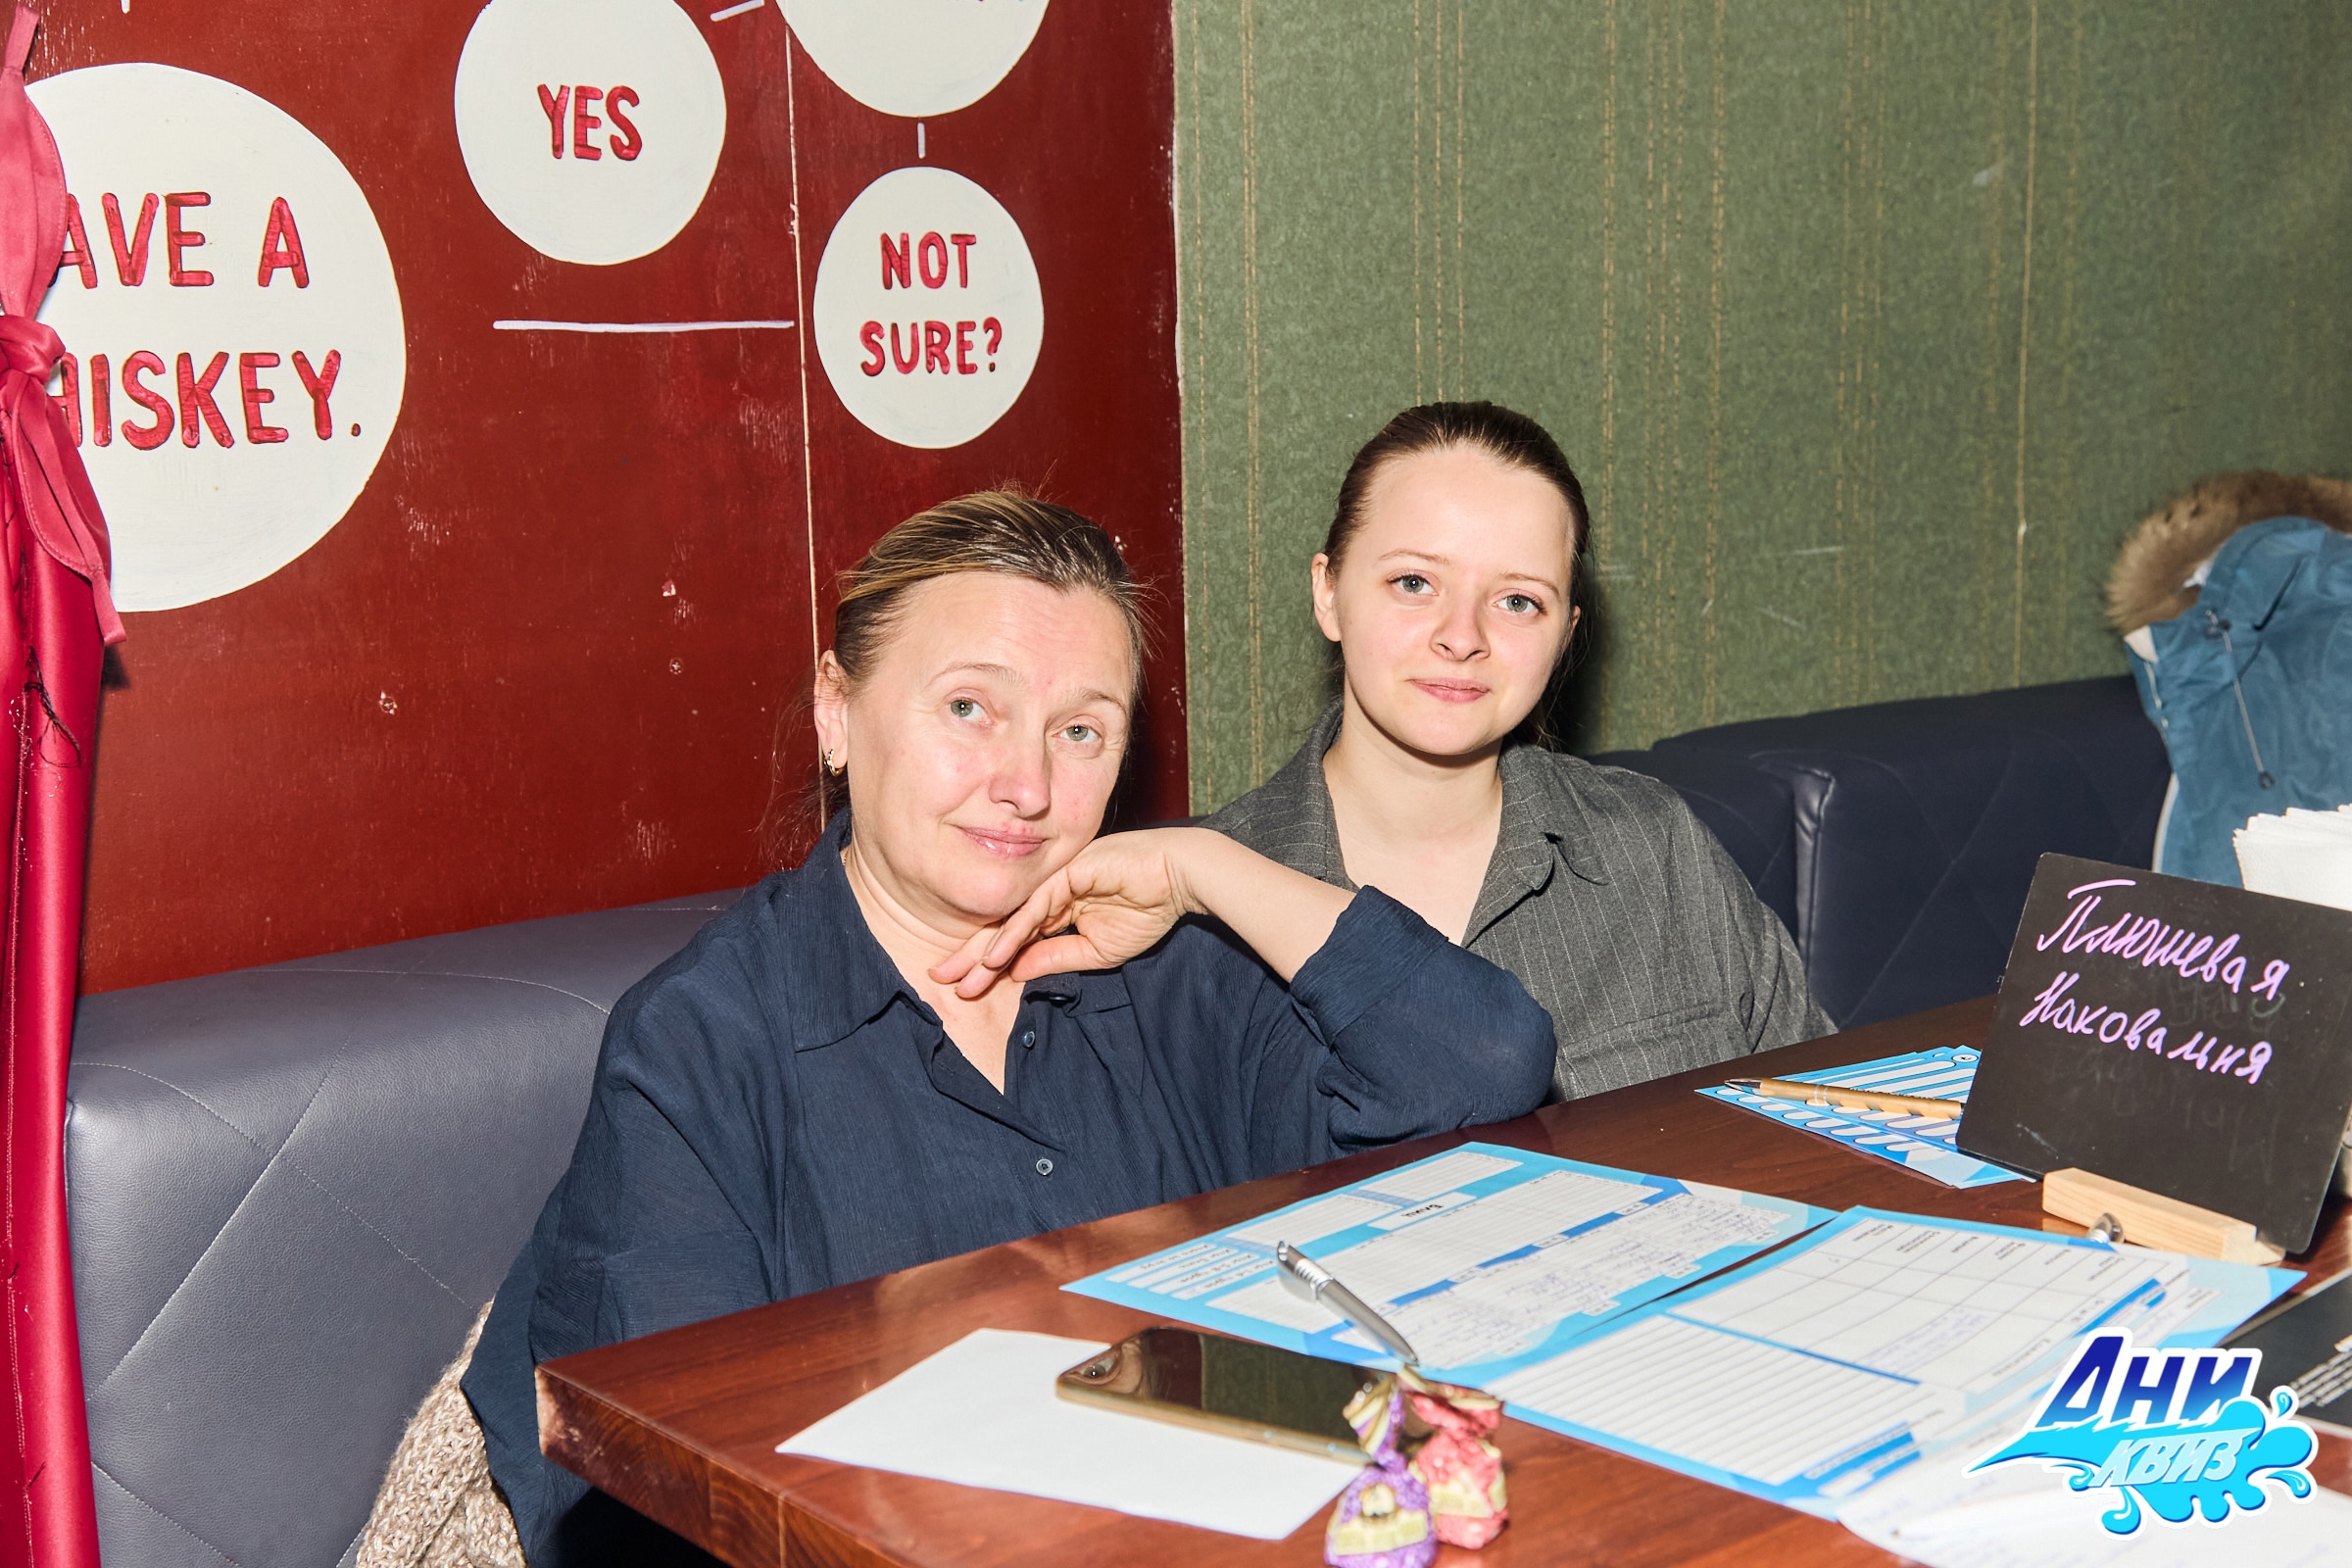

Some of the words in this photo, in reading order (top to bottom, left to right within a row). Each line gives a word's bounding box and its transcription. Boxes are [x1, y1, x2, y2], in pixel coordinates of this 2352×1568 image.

[536, 82, 643, 162] YES
[47, 191, 215, 289] AVE
[257, 195, 311, 288] A
[879, 230, 977, 290] NOT
[858, 316, 1003, 377] SURE?
[47, 348, 363, 451] ISKEY.
[2035, 878, 2290, 1001] Плюшевая
